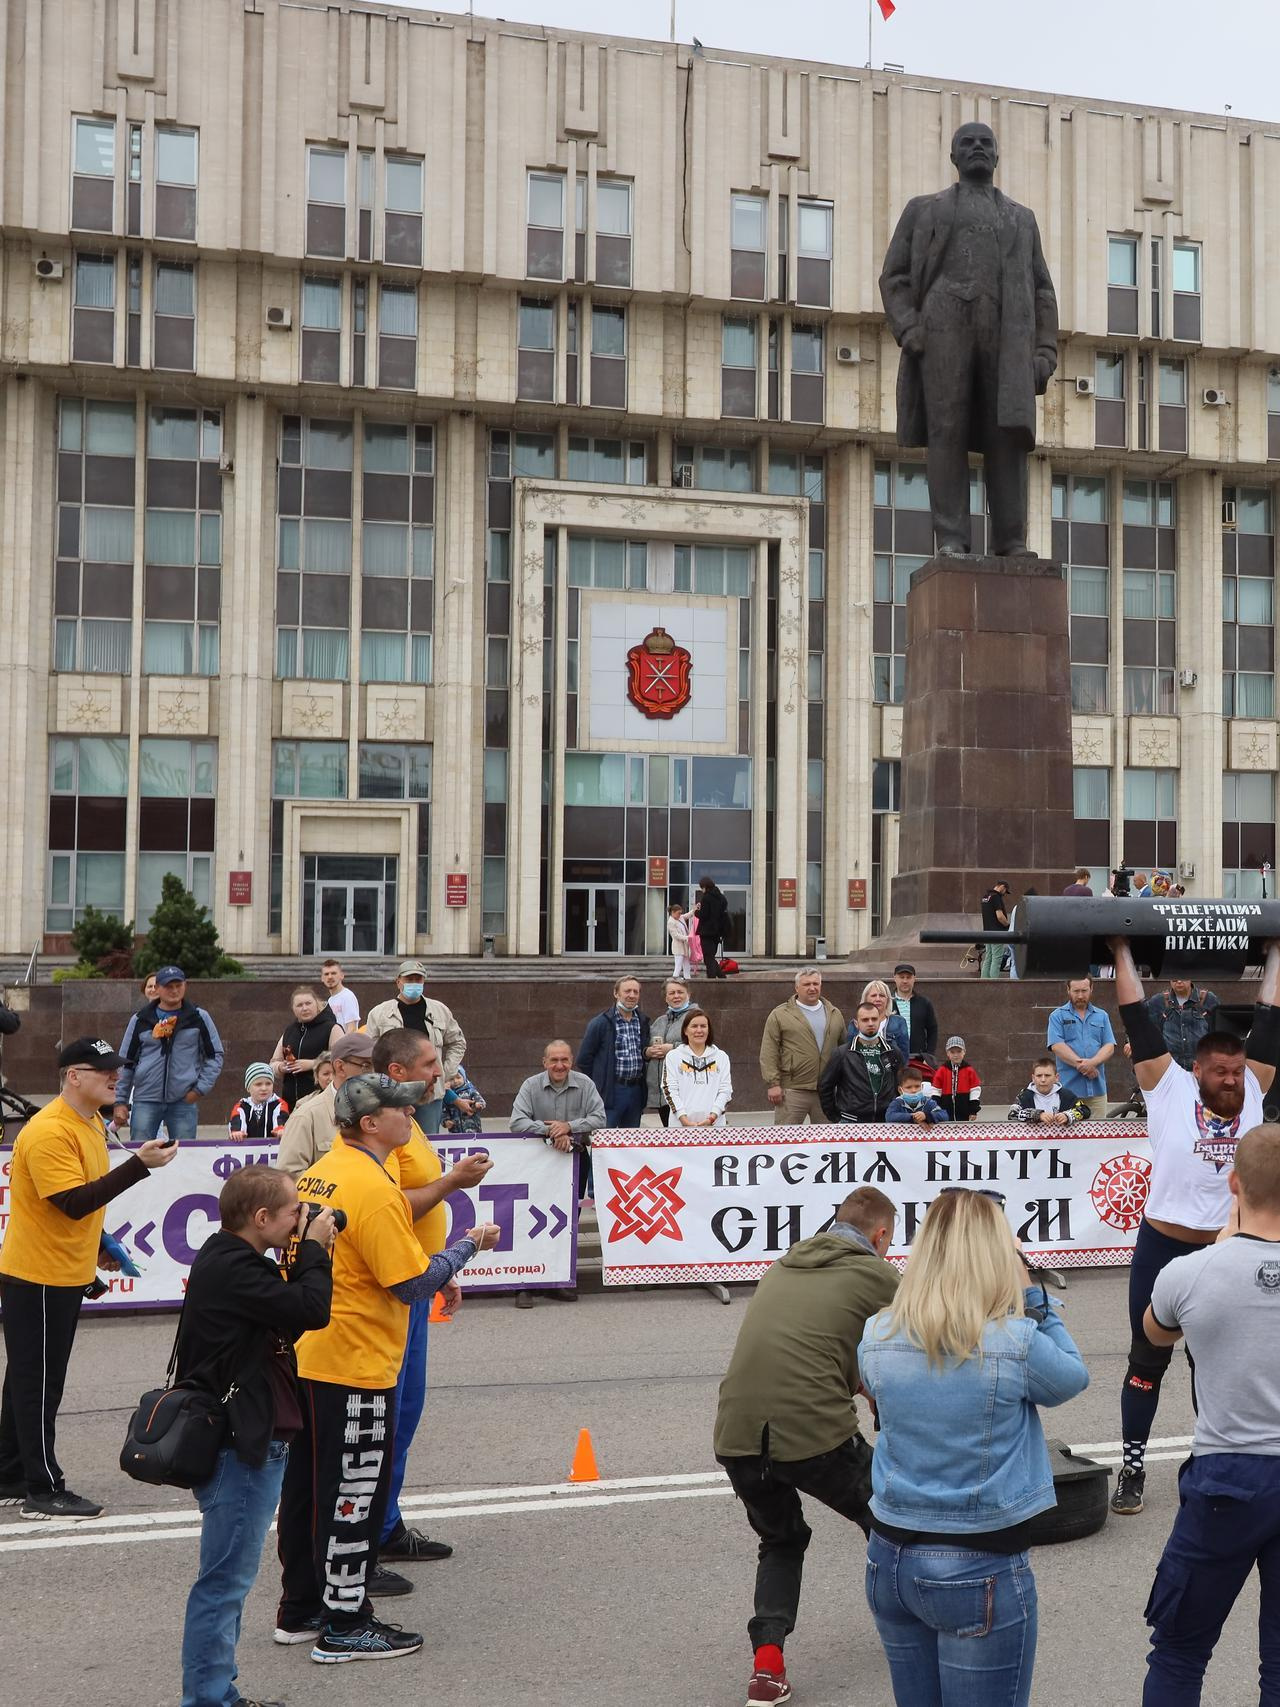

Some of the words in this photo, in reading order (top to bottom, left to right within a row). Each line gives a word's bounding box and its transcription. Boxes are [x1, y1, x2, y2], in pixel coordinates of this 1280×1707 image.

[1153, 904, 1261, 915] ФЕДЕРАЦИЯ
[1166, 916, 1248, 932] ТЯЖЁЛОЙ
[1165, 935, 1249, 950] АТЛЕТИКИ
[924, 1149, 1072, 1182] БЫТЬ
[297, 1177, 338, 1199] СУДЬЯ
[463, 1267, 493, 1277] вход
[495, 1266, 502, 1275] с
